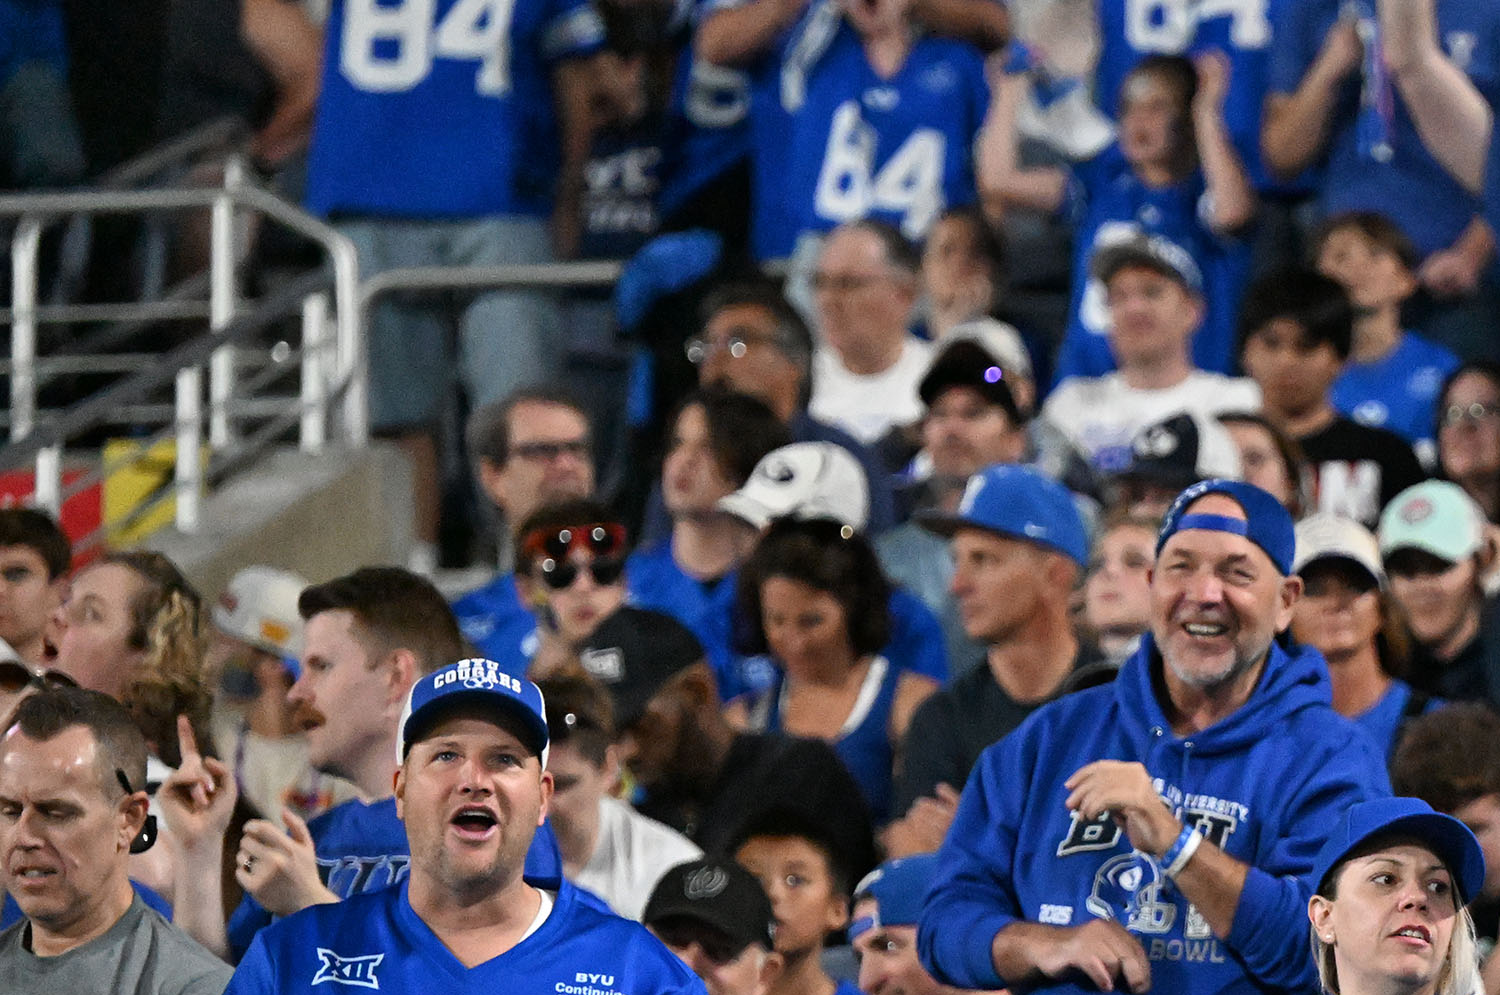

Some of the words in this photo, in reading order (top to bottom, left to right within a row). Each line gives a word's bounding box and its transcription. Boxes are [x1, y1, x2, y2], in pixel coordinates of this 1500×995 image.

[340, 0, 512, 97] 84
[456, 657, 499, 673] BYU
[433, 666, 522, 695] COUGARS
[1056, 806, 1239, 858] BU
[1150, 938, 1225, 965] BOWL
[575, 972, 615, 987] BYU
